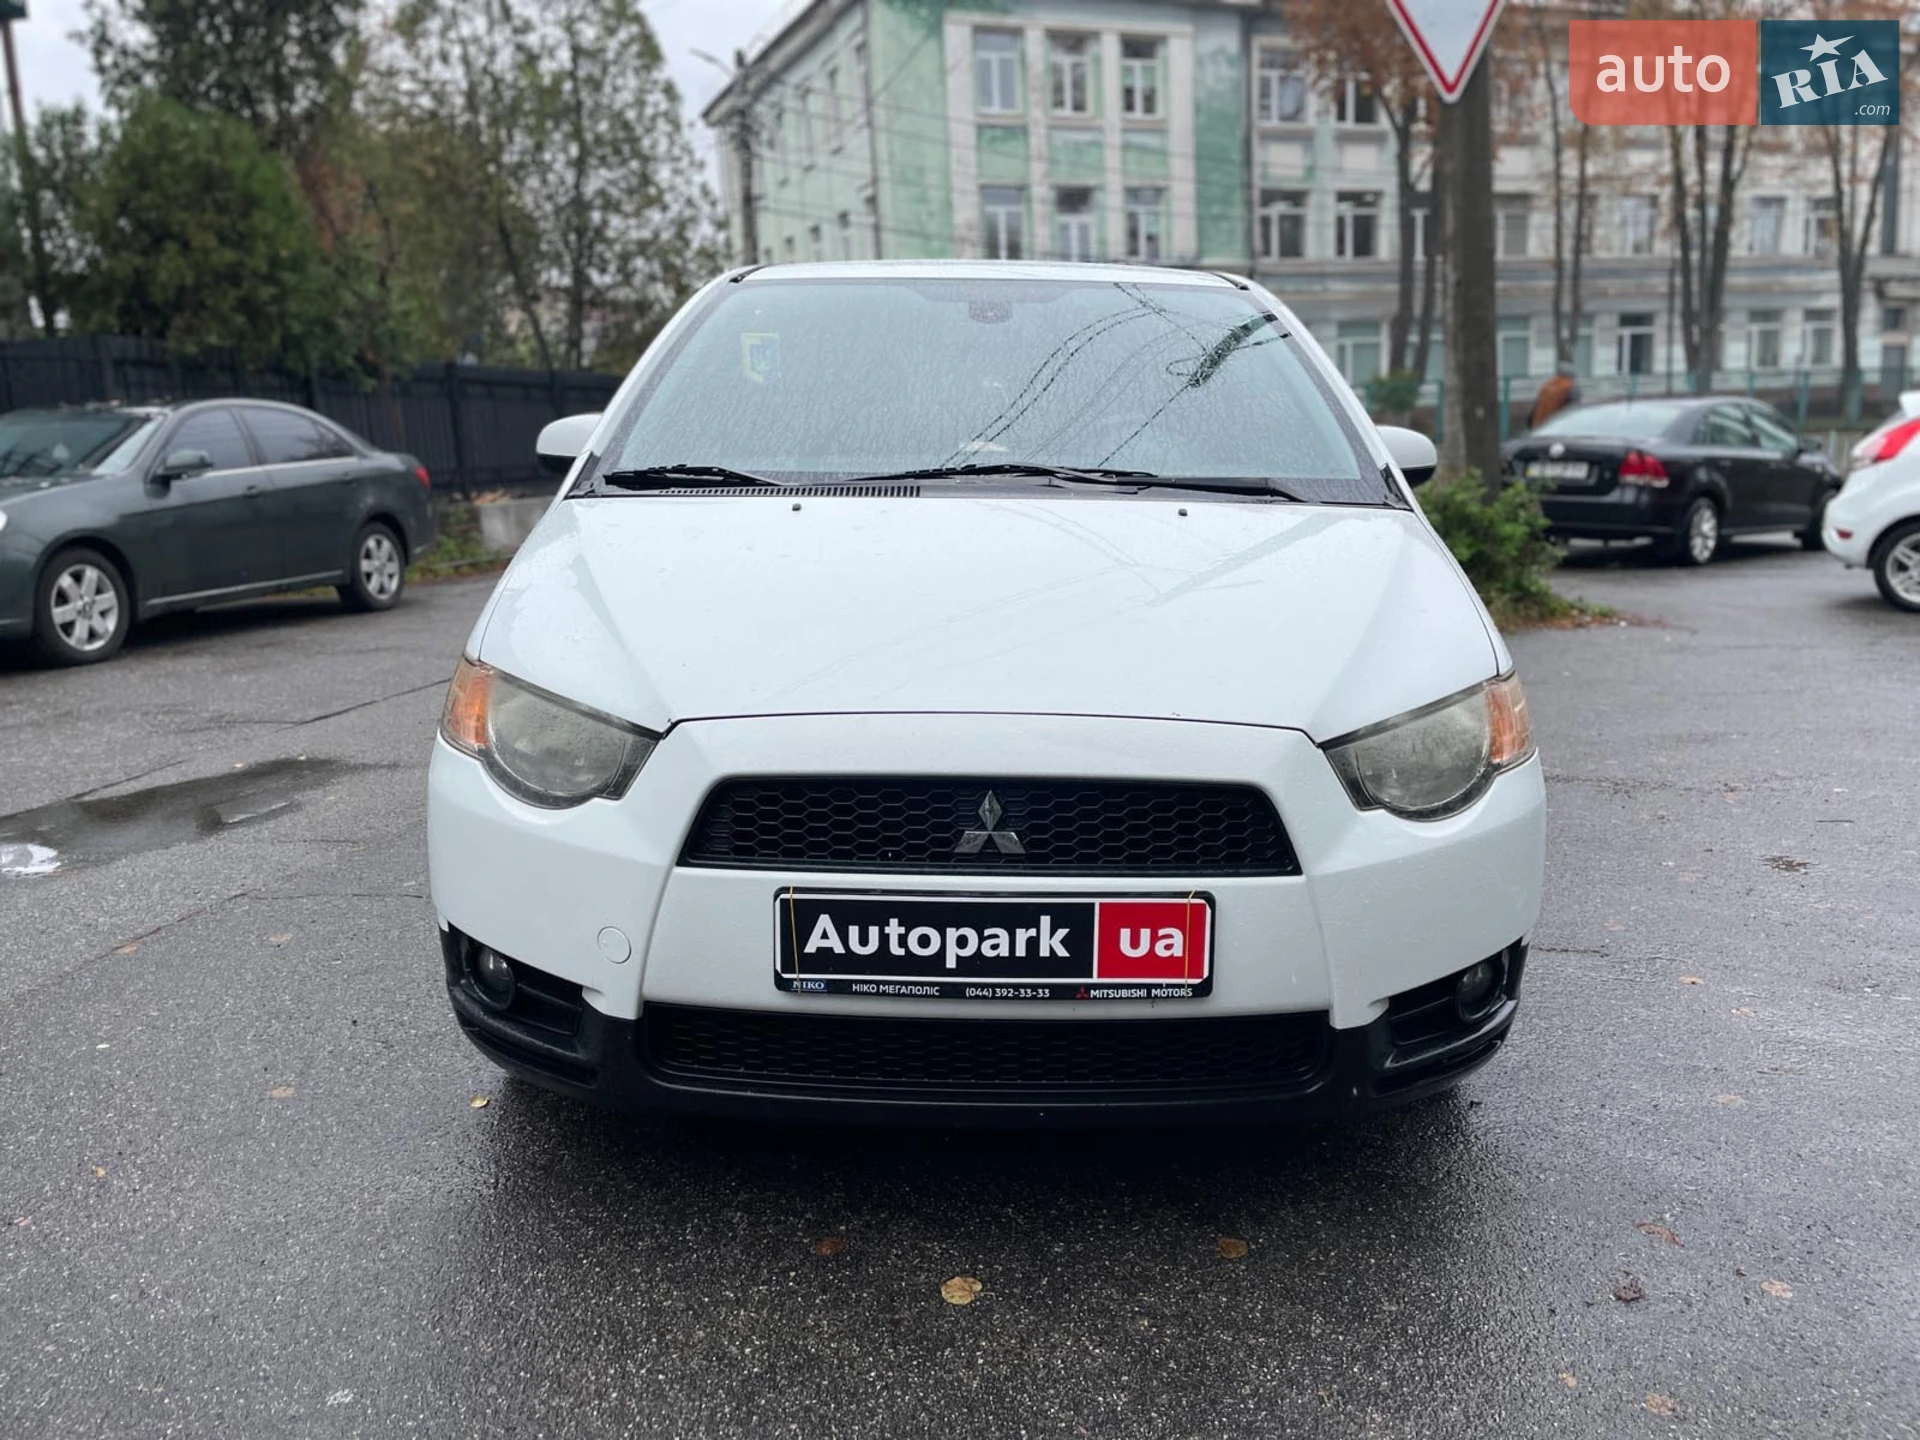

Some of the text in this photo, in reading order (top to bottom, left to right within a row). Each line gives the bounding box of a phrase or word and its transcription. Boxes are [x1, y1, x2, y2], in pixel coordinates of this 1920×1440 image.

[803, 913, 1071, 969] Autopark
[1118, 925, 1185, 958] ua
[792, 981, 825, 990] NIKO
[879, 984, 940, 996] МЕГАПОЛІС
[965, 987, 1050, 998] (044) 392-33-33
[1090, 987, 1193, 998] MITSUBISHI MOTORS
